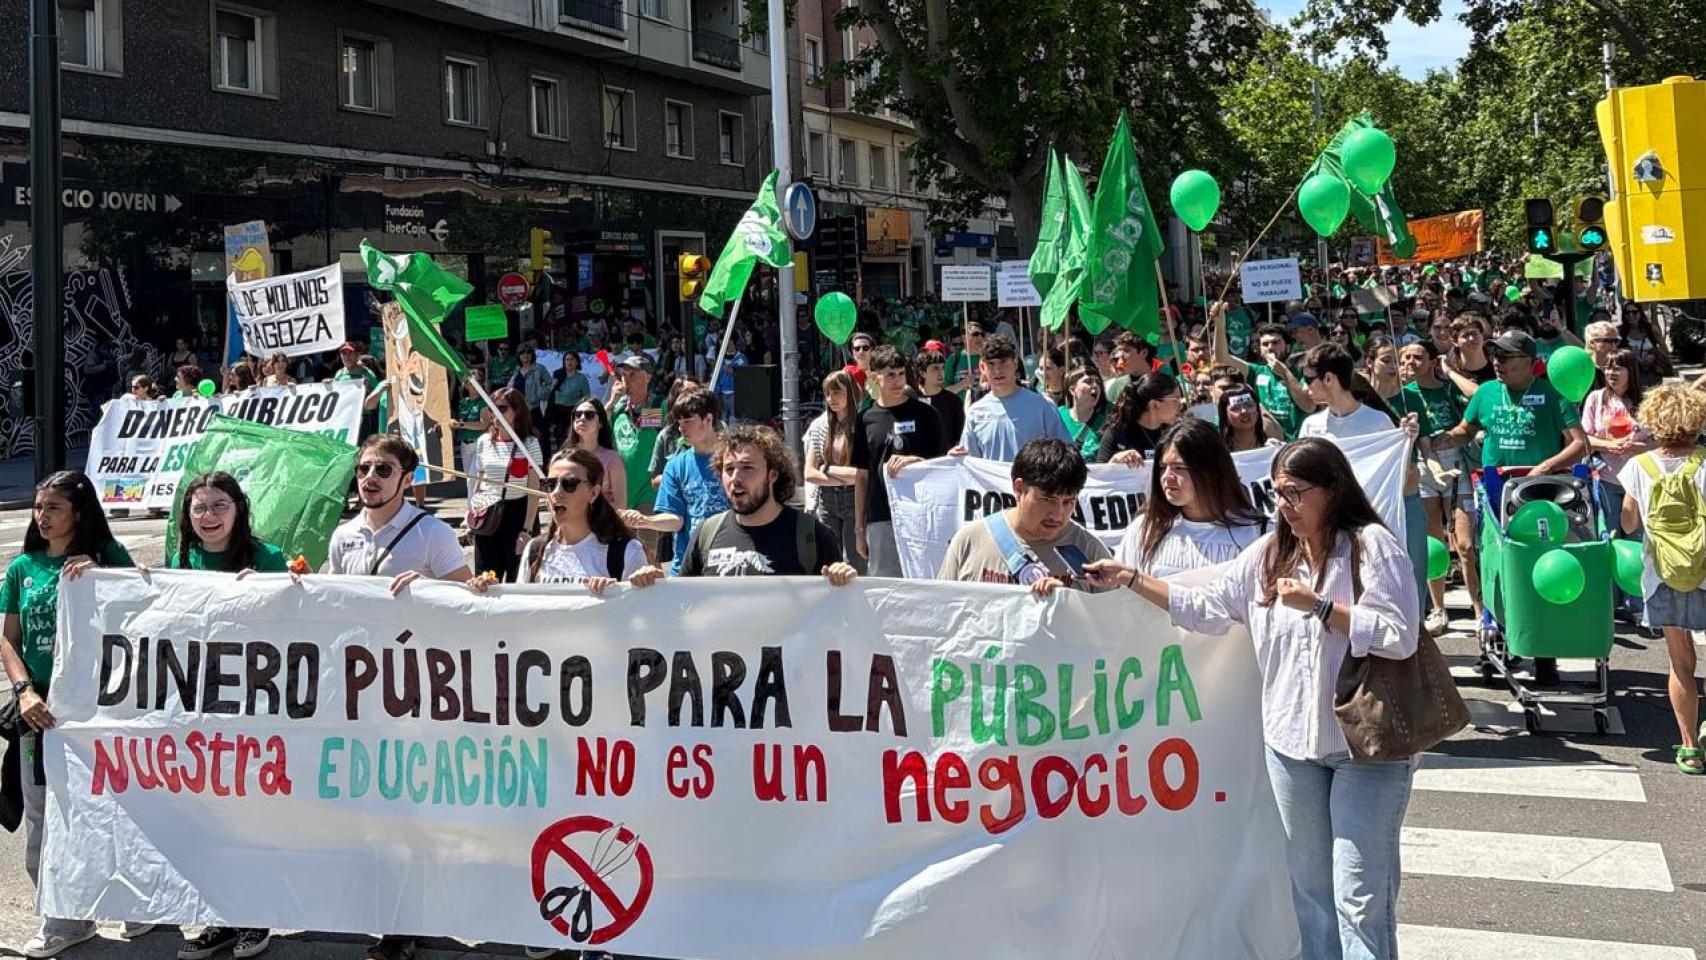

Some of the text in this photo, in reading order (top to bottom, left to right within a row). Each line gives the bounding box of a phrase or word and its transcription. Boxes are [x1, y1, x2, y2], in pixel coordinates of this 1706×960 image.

[100, 191, 156, 212] JOVEN
[385, 204, 424, 217] Fundación
[243, 289, 262, 317] DE
[118, 404, 220, 439] DINERO
[98, 456, 137, 474] PARA
[140, 456, 160, 474] LA
[96, 633, 319, 719] DINERO
[626, 646, 792, 730] PARA
[827, 649, 908, 737] LA
[666, 744, 714, 800] es
[753, 743, 828, 802] un
[882, 737, 1227, 835] negocio.
